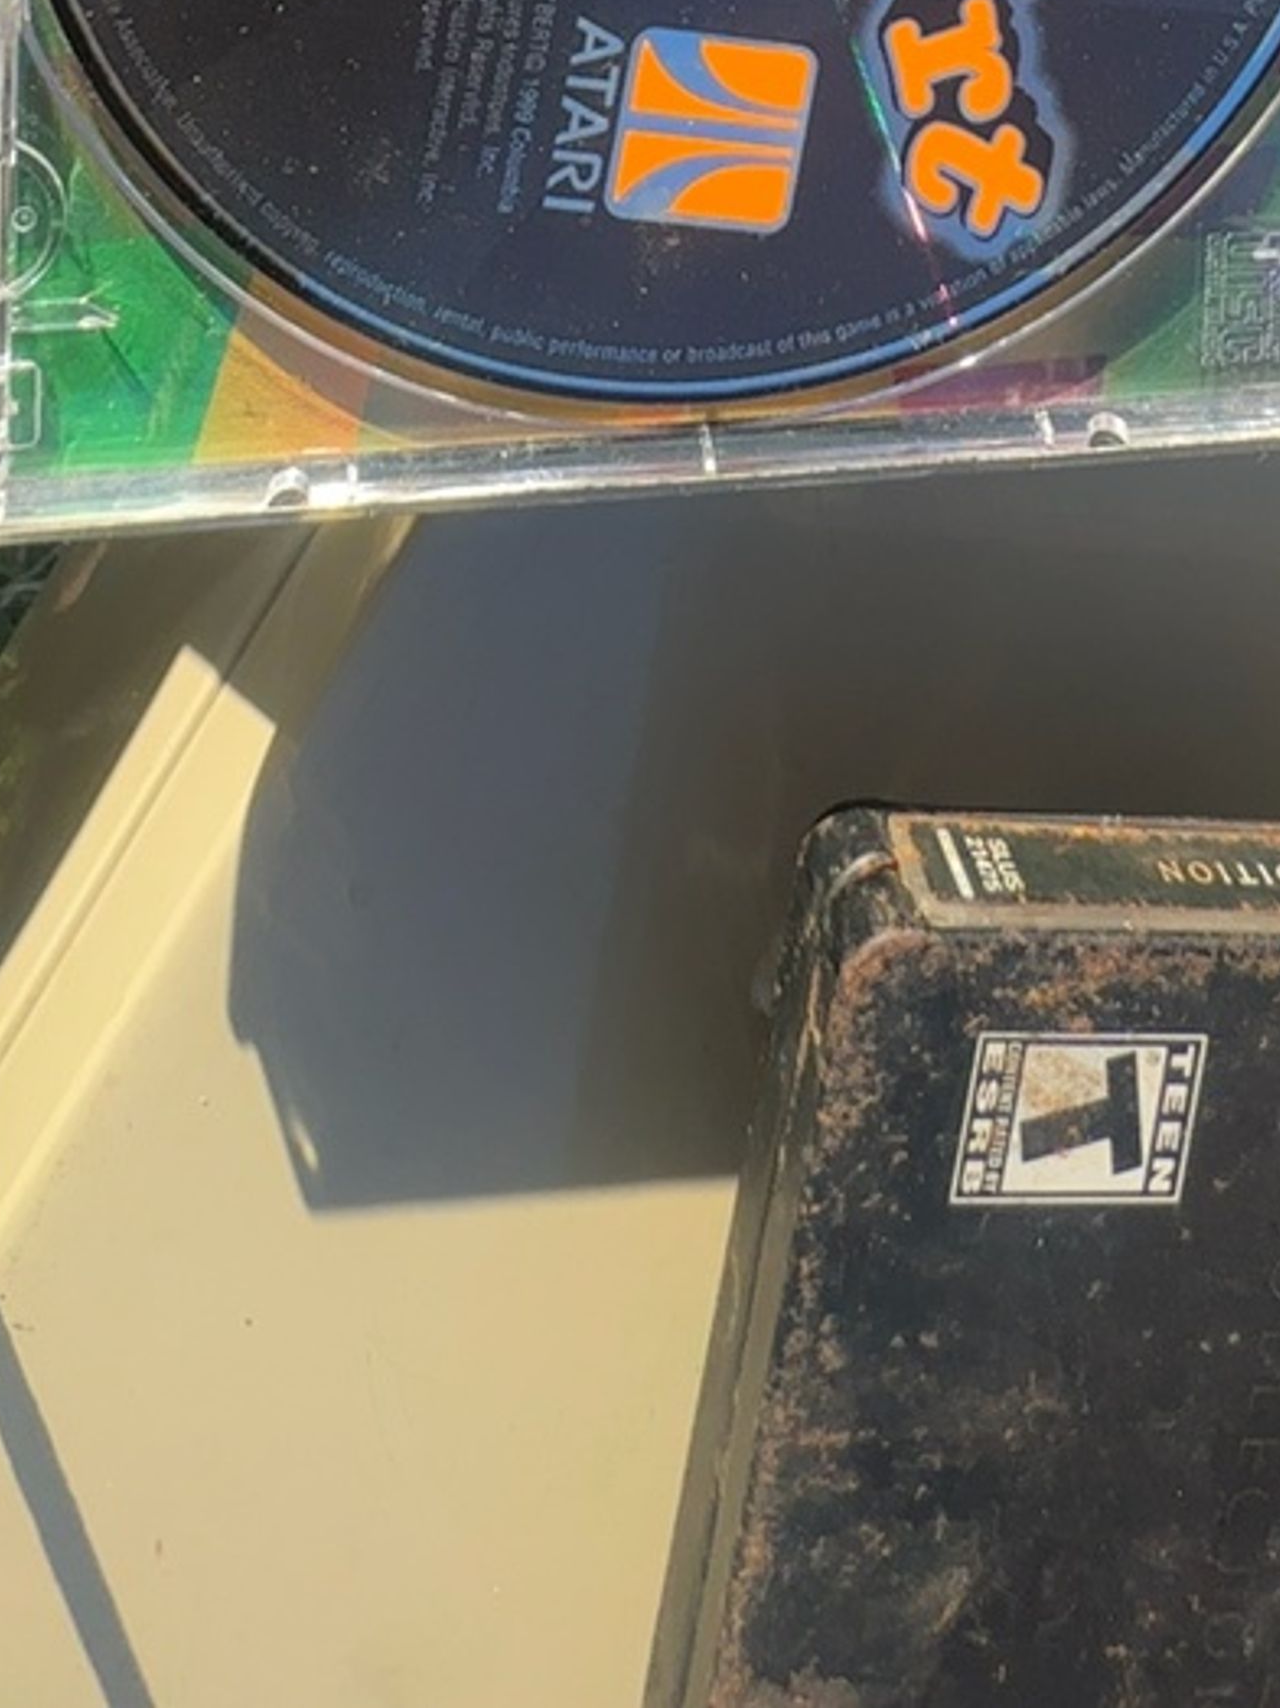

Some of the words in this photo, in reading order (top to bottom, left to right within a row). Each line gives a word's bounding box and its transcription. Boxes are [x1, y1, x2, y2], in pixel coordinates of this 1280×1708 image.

[542, 16, 625, 213] ATARI
[987, 837, 1026, 893] SLUS
[961, 1042, 1007, 1194] ESRB
[1019, 1050, 1143, 1175] T
[1148, 1043, 1196, 1192] TEEN
